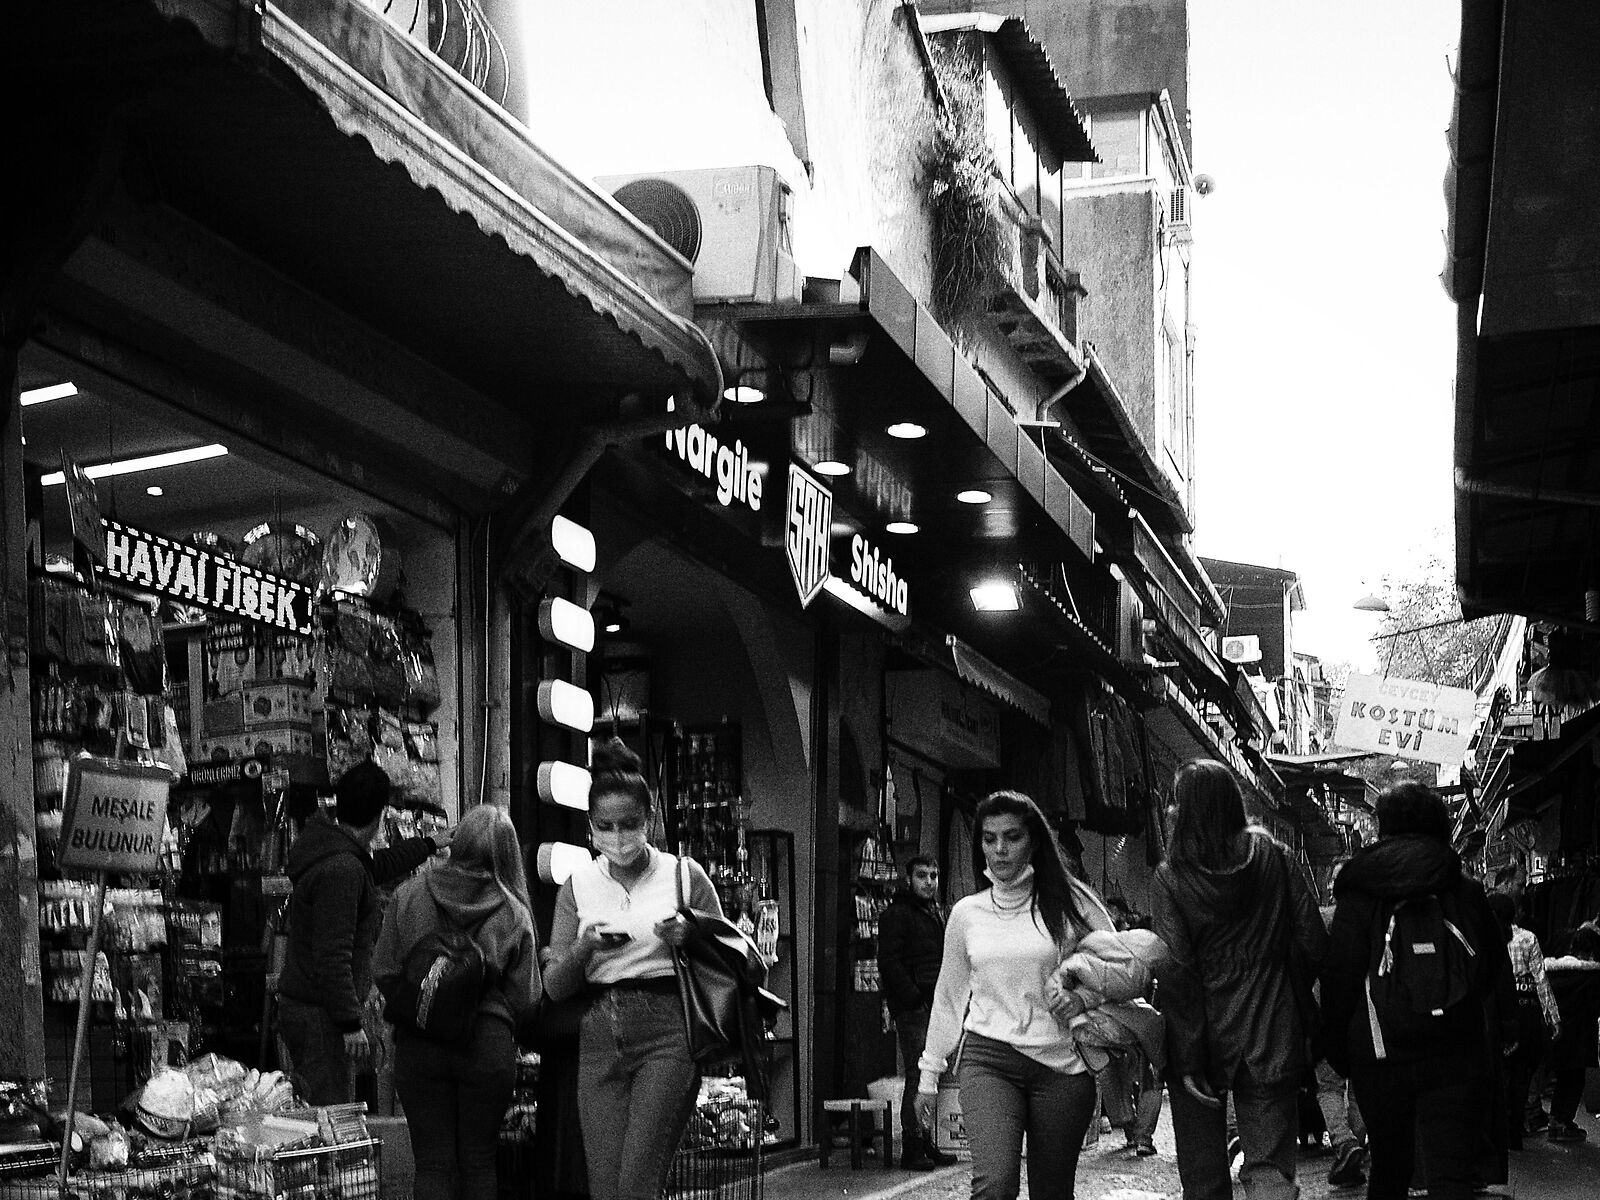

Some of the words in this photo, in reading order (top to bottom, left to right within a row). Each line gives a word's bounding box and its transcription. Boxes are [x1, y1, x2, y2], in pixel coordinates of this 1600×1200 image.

[851, 534, 908, 616] Shisha
[1351, 701, 1459, 735] KOSTÜM
[1378, 728, 1423, 751] EVİ
[91, 795, 156, 823] MEŞALE
